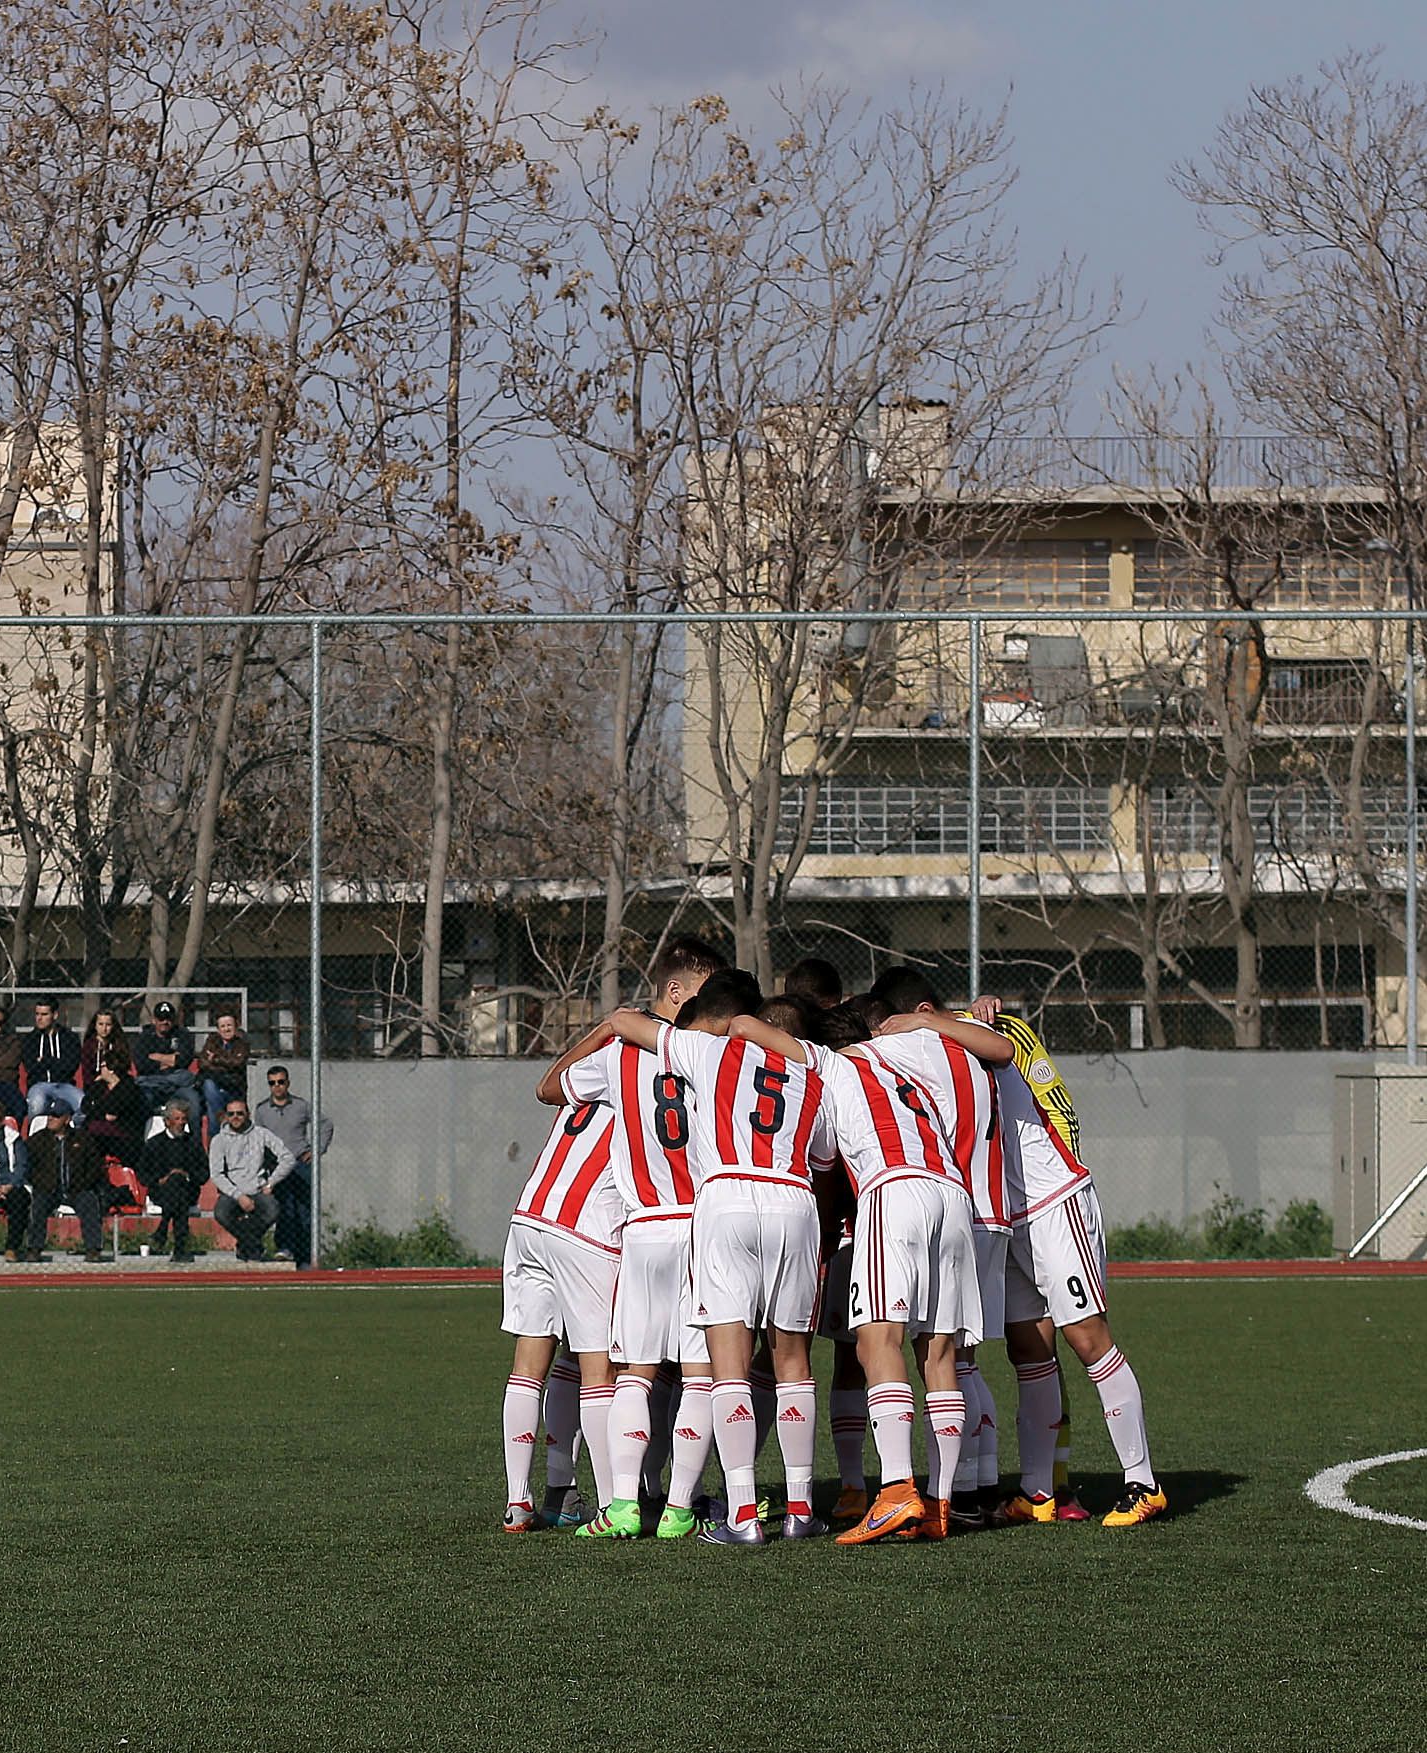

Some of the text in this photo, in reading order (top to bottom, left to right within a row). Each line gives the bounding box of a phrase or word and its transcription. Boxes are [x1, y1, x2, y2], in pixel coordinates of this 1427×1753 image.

[653, 1072, 690, 1150] 8
[749, 1066, 790, 1135] 5
[850, 1282, 863, 1317] 2
[1066, 1275, 1088, 1309] 9
[726, 1414, 755, 1424] adidas
